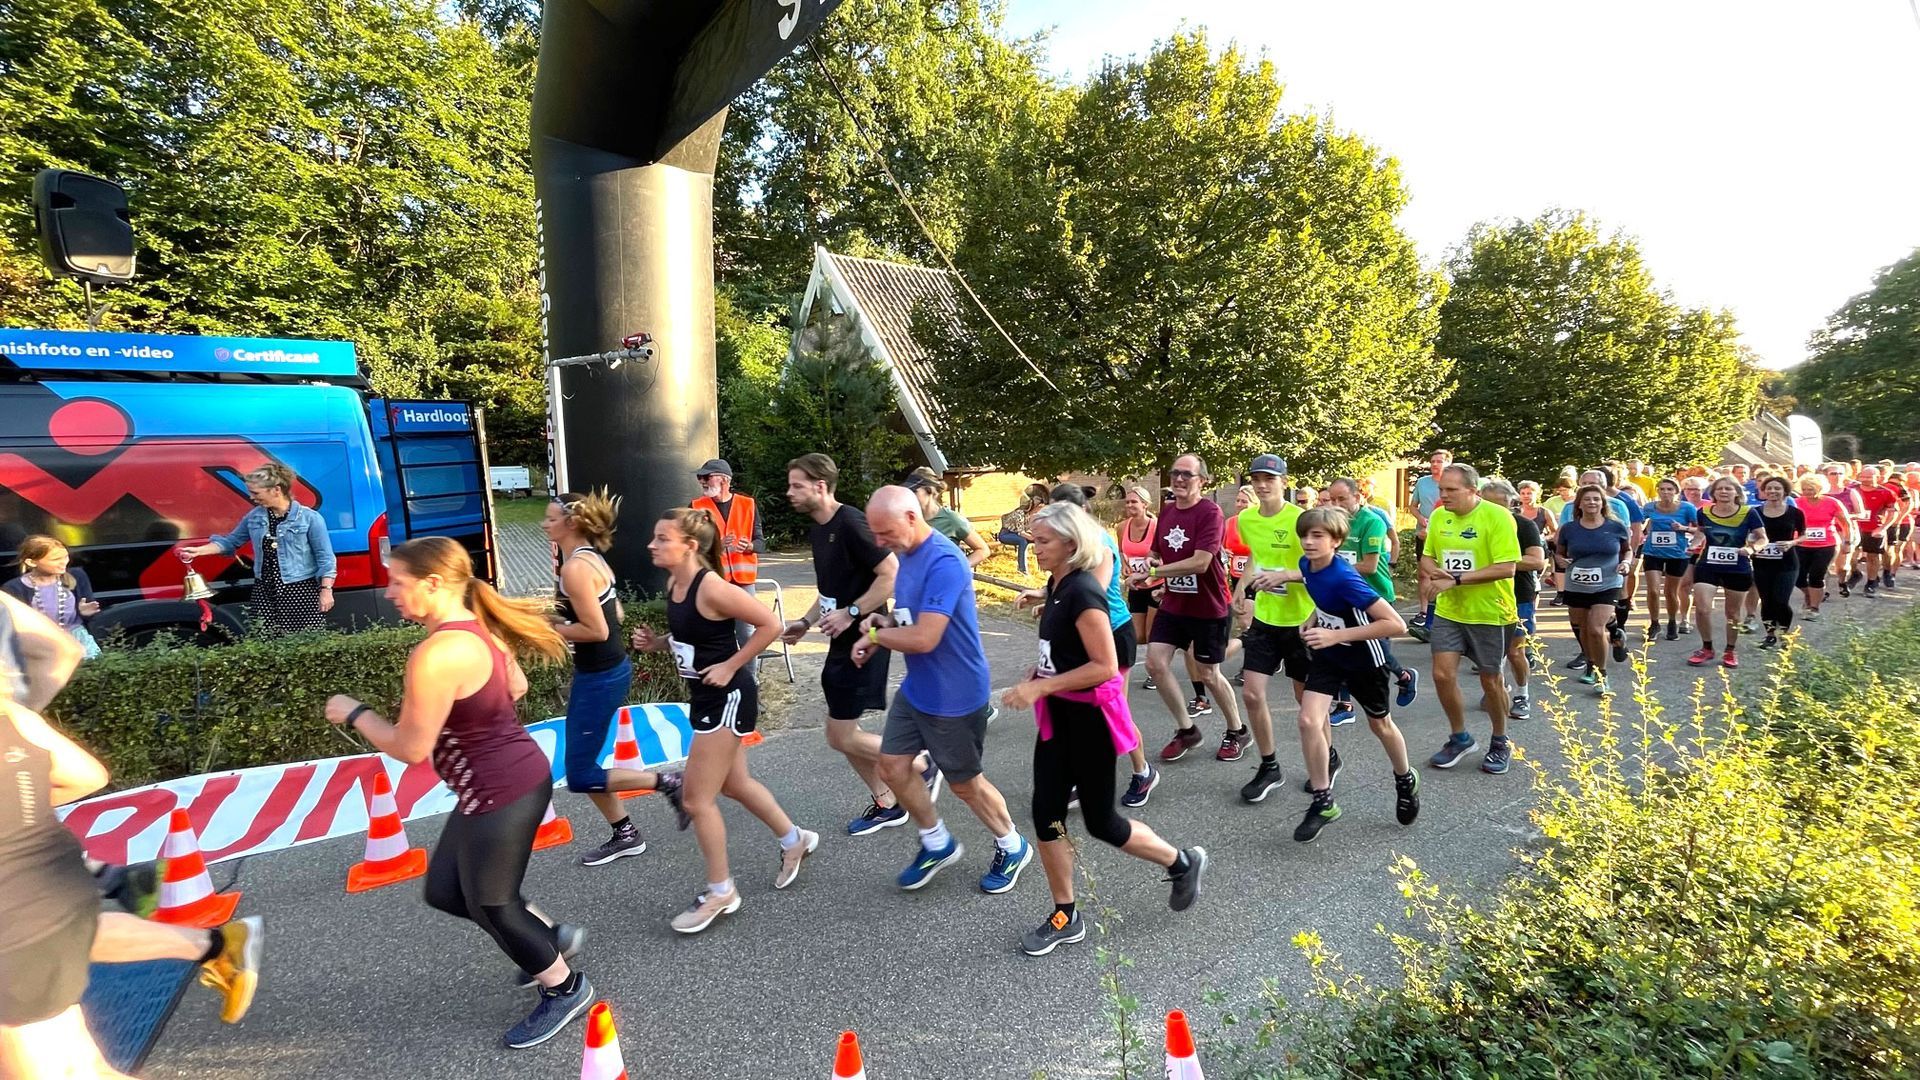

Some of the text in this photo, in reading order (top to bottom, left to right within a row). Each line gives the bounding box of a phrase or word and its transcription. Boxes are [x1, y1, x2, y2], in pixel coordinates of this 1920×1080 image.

[86, 347, 110, 357] en
[1710, 551, 1736, 560] 166
[1445, 558, 1472, 570] 129
[1573, 573, 1600, 582] 220
